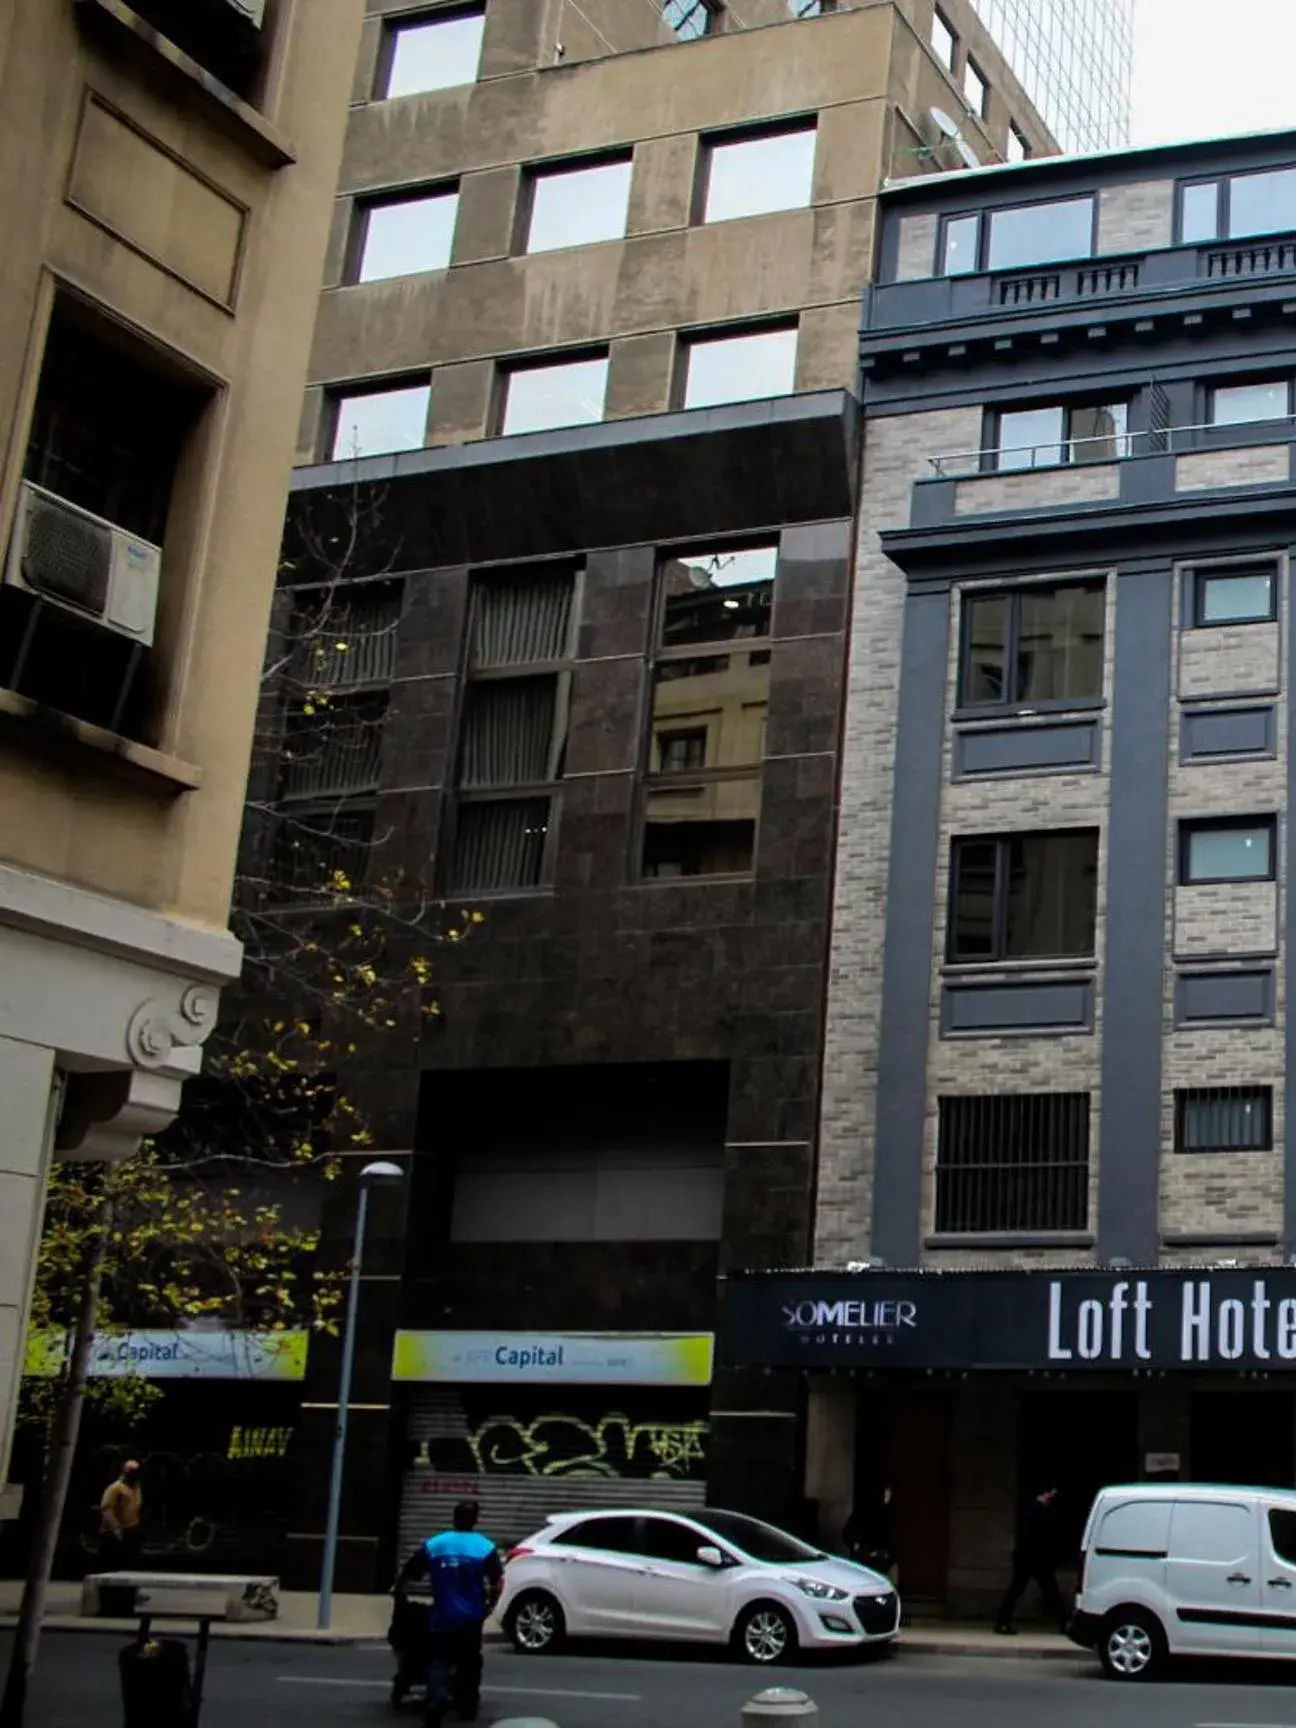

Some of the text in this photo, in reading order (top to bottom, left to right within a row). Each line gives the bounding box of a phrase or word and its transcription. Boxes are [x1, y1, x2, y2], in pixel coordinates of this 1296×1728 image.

[781, 1300, 917, 1328] SOMELIER
[1049, 1281, 1152, 1359] Loft
[495, 1345, 564, 1369] Capital
